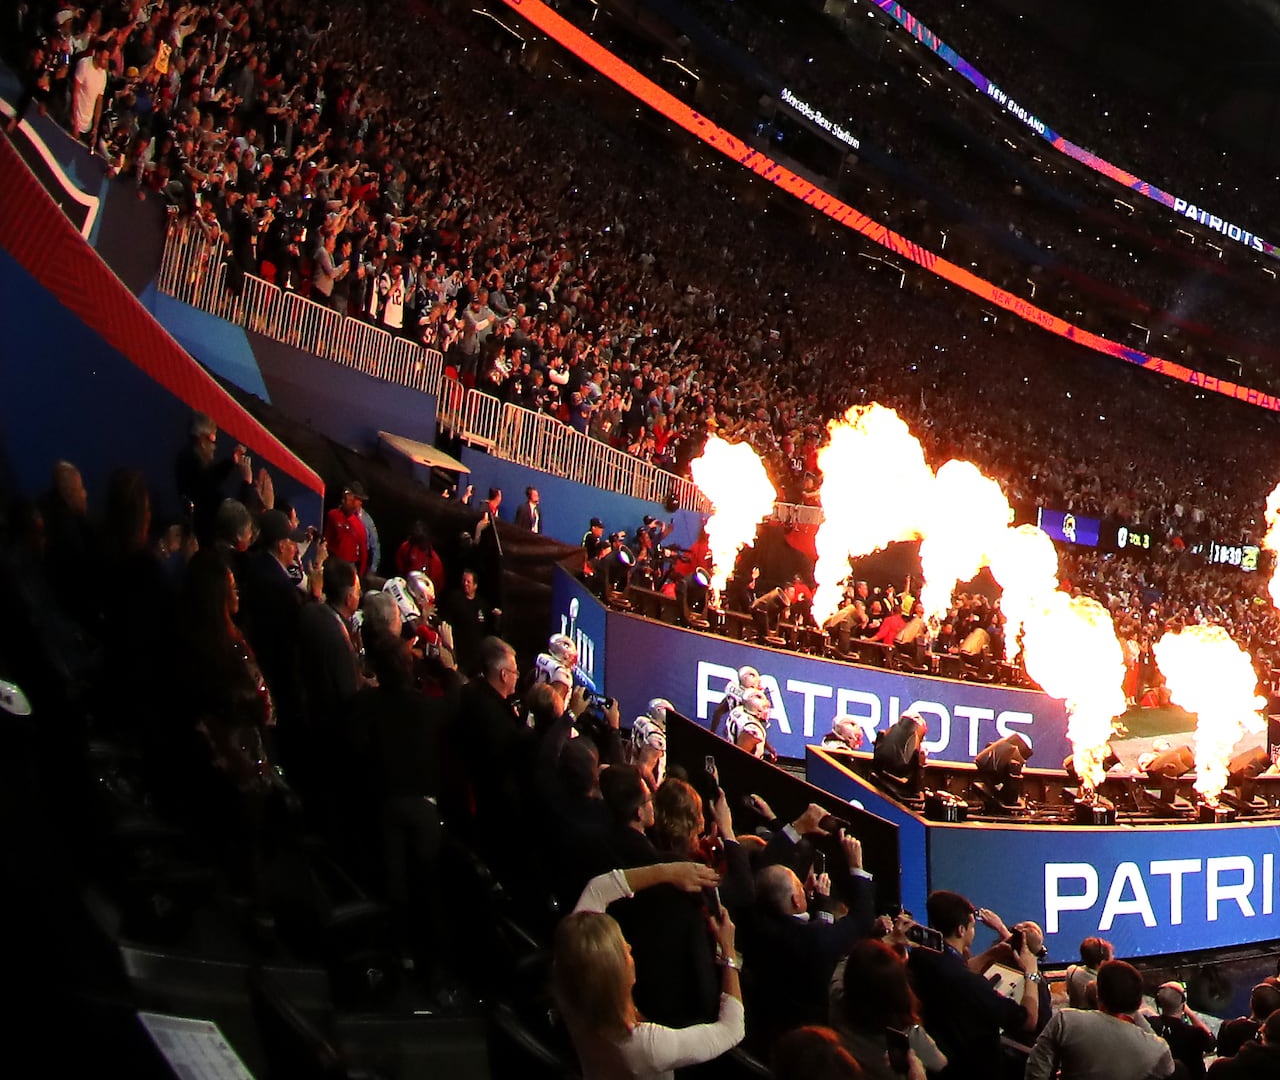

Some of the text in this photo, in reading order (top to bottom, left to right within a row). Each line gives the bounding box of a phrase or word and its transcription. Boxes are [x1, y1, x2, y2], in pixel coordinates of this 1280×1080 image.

[987, 83, 1045, 135] NEW ENGLAND
[1172, 197, 1266, 253] PATRIOTS
[696, 660, 1034, 762] PATRIOTS
